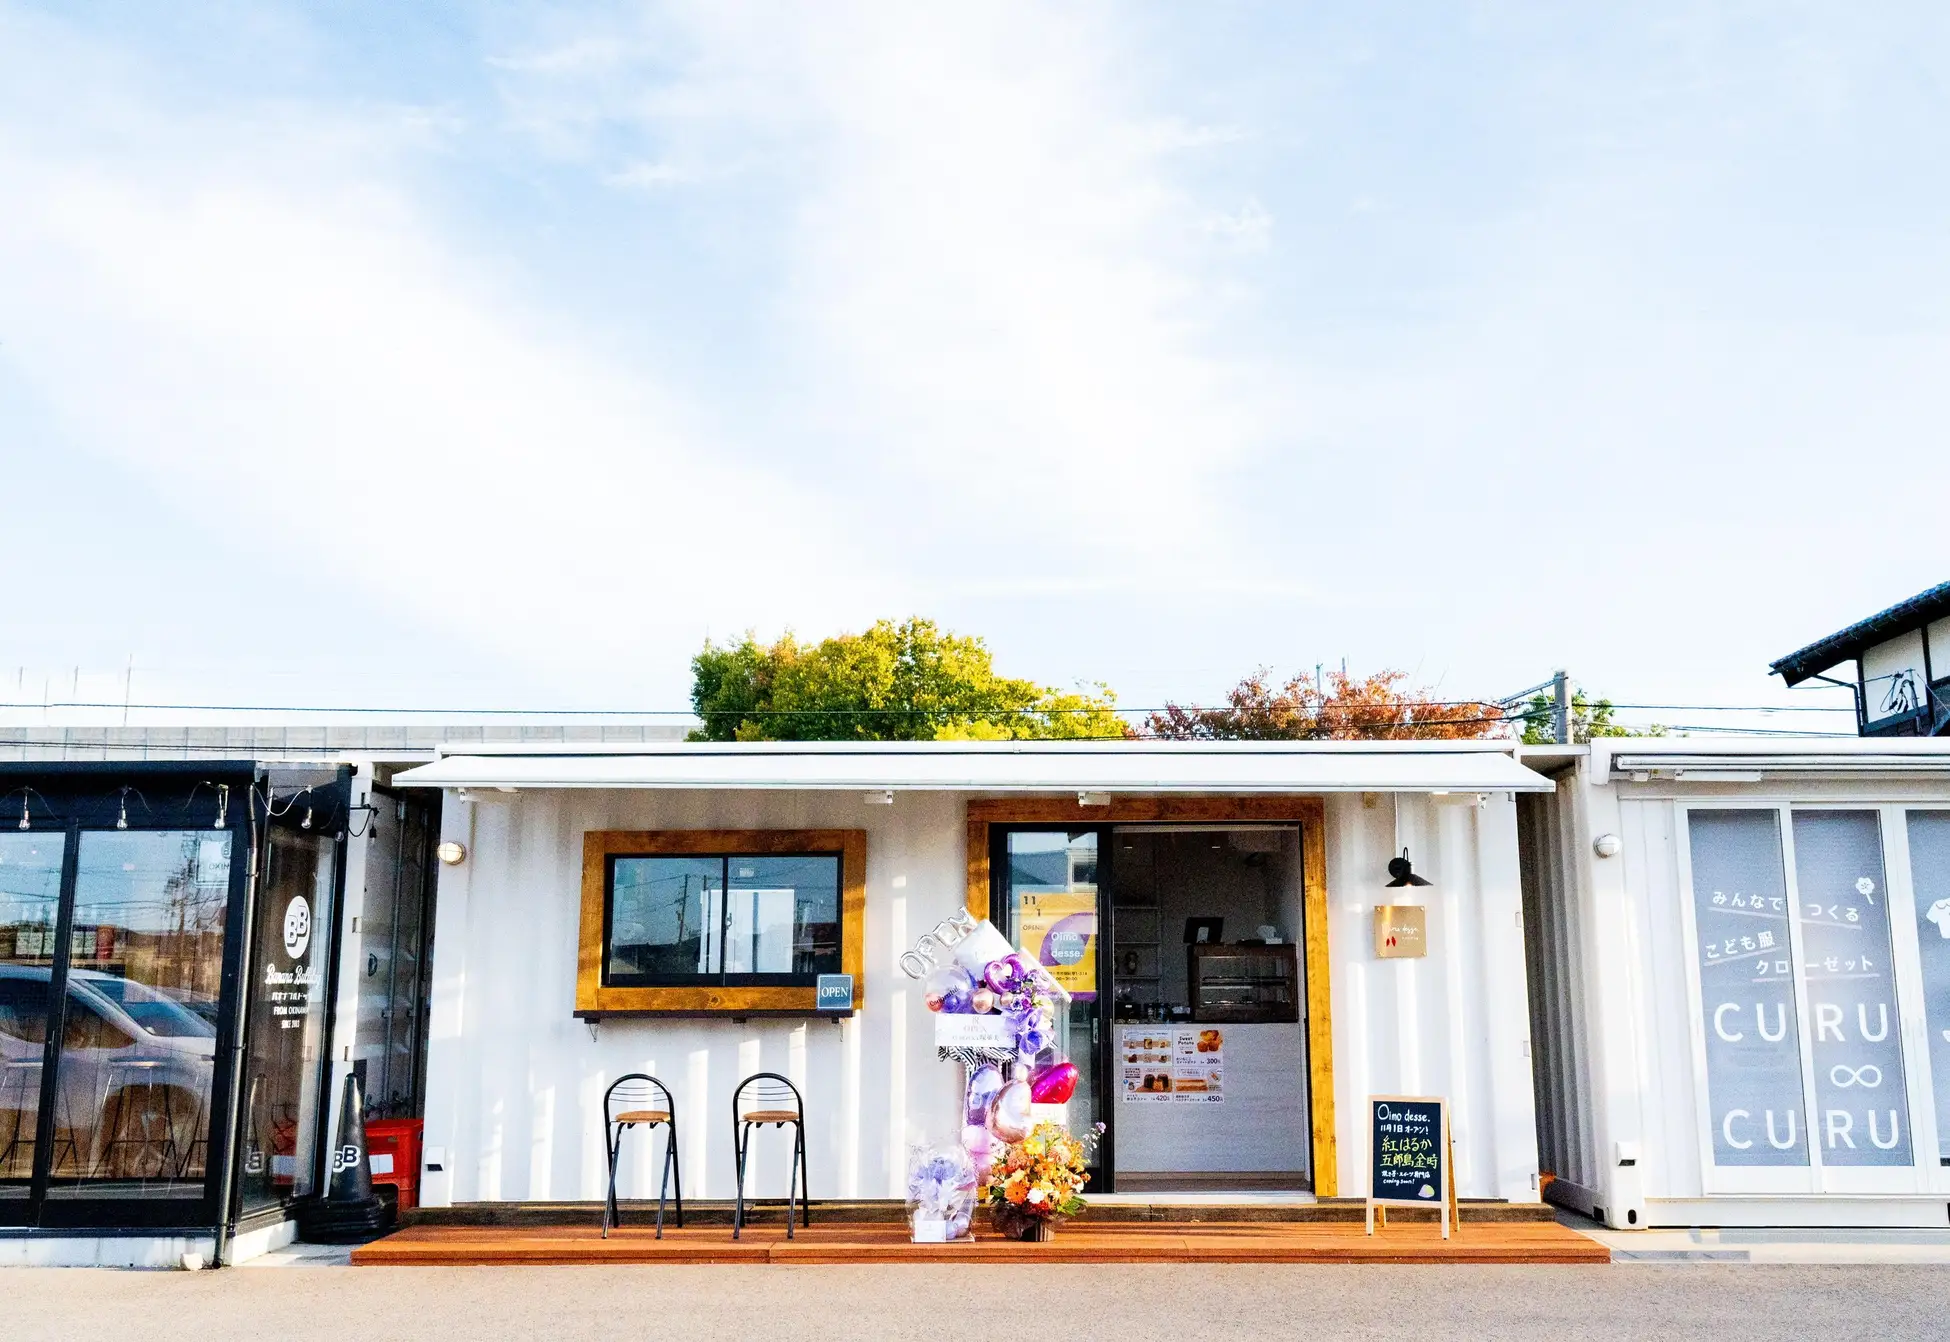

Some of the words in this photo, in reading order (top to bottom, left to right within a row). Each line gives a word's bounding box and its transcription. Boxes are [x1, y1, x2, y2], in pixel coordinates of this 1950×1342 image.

[1051, 931, 1078, 941] Oimo
[1051, 949, 1083, 958] desse.
[1705, 931, 1775, 959] こども服
[821, 986, 849, 998] OPEN
[1377, 1103, 1402, 1121] Oimo
[1404, 1109, 1431, 1123] desse.
[1381, 1135, 1433, 1152] 紅はるか
[1380, 1152, 1439, 1169] 五郎島金時
